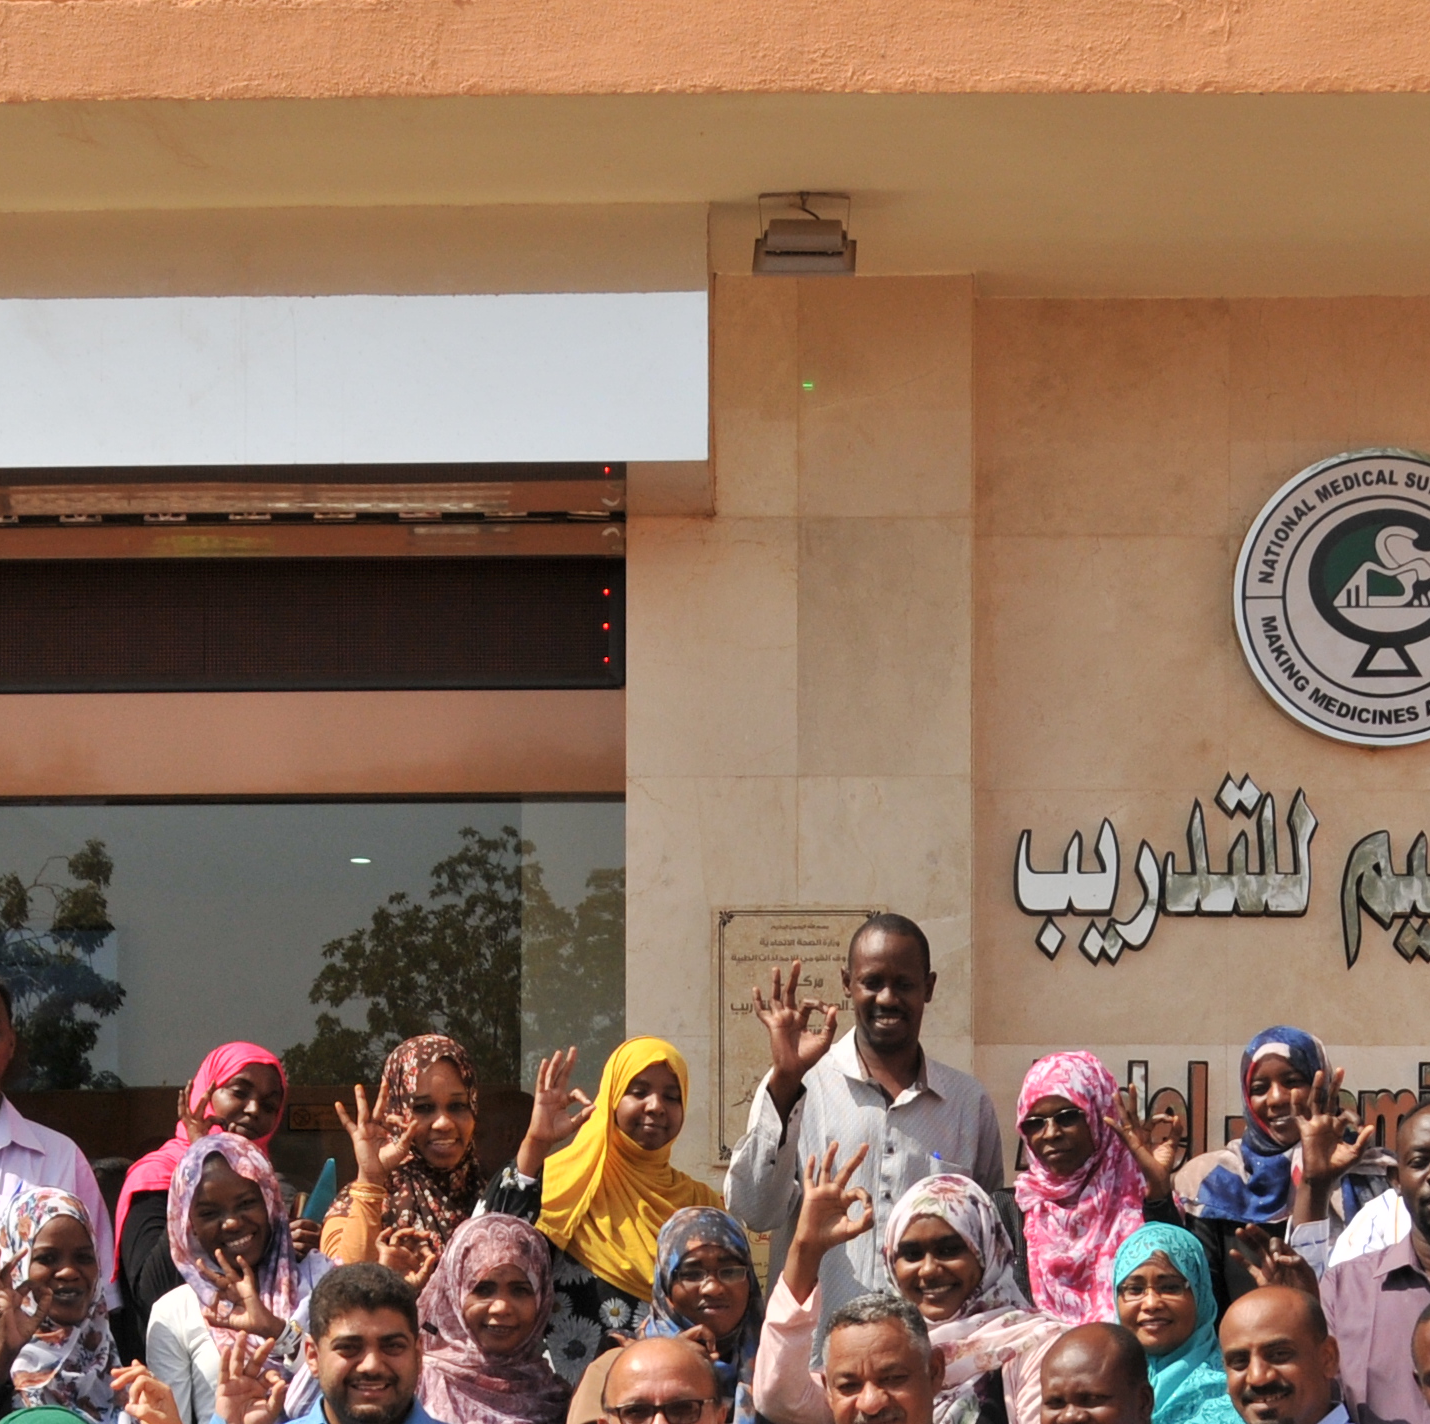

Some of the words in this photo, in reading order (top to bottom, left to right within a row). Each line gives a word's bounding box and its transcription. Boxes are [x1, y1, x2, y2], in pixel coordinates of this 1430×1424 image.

[1258, 499, 1316, 584] NATIONAL
[1314, 470, 1398, 504] MEDICAL
[1261, 616, 1310, 692] MAKING
[1308, 687, 1419, 725] MEDICINES
[1013, 772, 1319, 967] للتدريب
